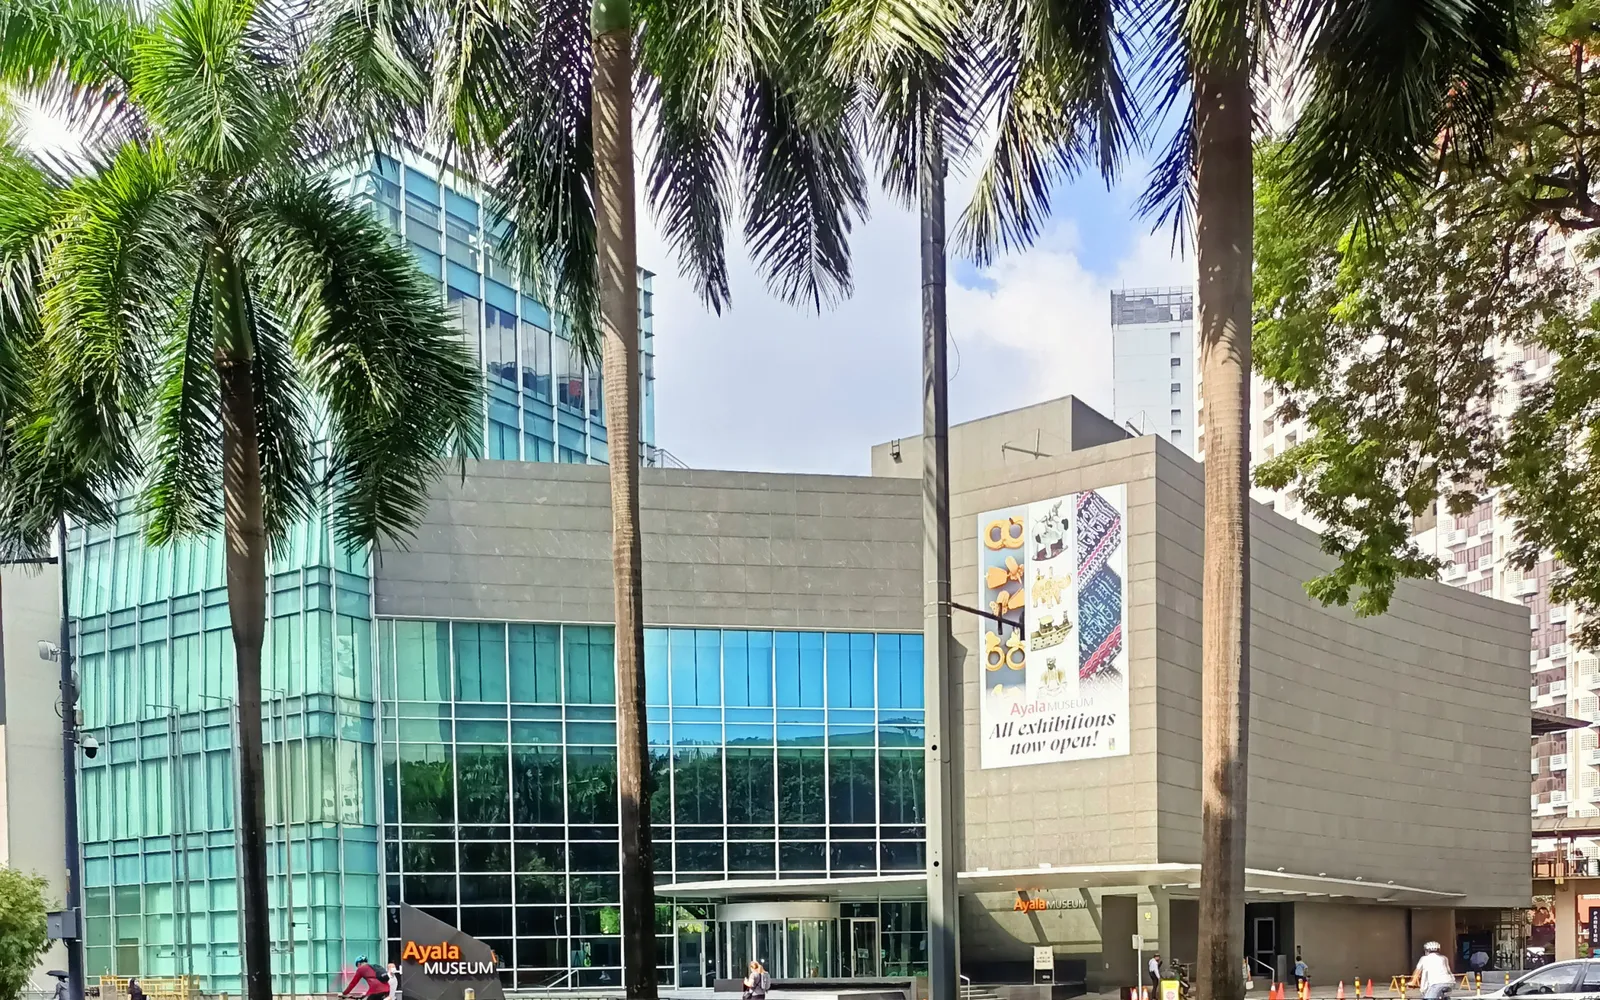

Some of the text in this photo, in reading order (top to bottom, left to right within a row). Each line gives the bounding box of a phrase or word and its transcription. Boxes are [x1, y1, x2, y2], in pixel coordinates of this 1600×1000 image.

[1010, 697, 1094, 718] Ayala MUSEUM
[989, 712, 1117, 740] All exhibitions
[1010, 730, 1099, 755] now open!
[1013, 897, 1088, 914] Ayala MUSEUM
[402, 940, 460, 964] Ayala
[424, 961, 494, 975] MUSEUM
